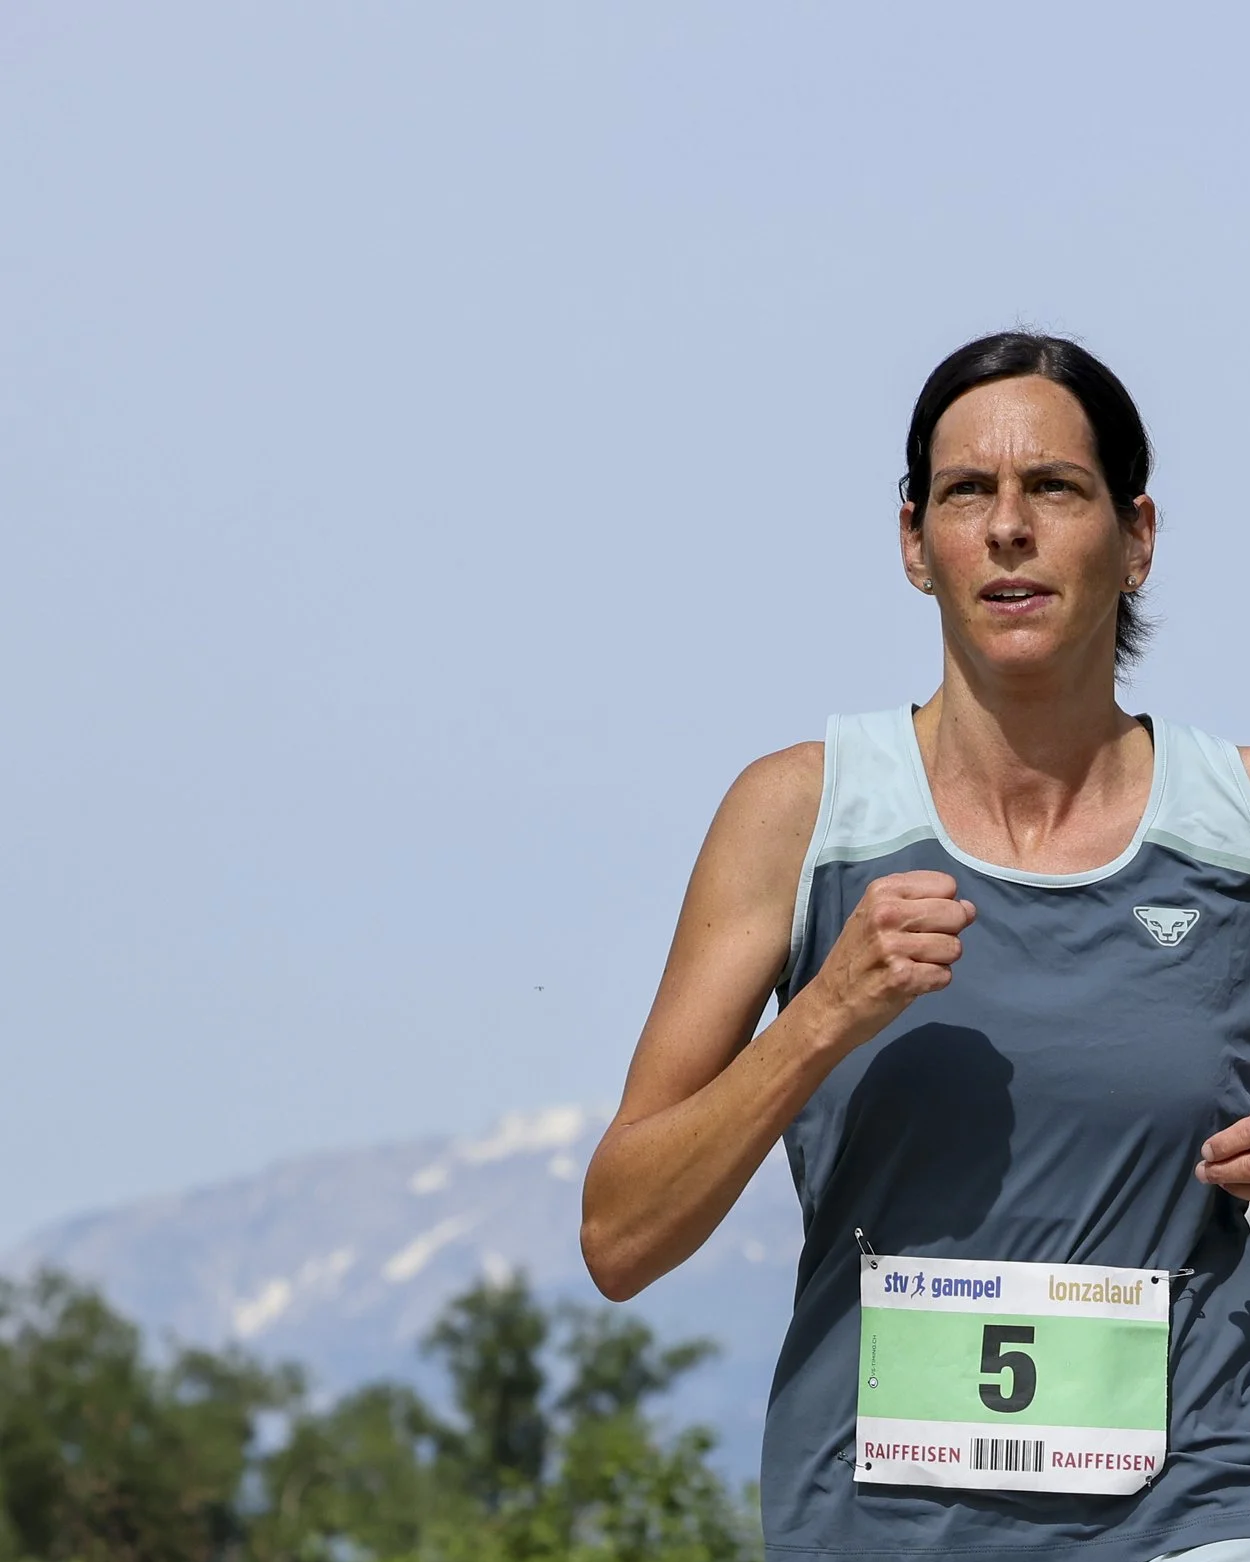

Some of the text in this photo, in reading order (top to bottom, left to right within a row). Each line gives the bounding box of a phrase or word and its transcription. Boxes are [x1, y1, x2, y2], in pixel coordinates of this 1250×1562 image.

[884, 1271, 1143, 1305] stv gampel lonzalauf
[978, 1324, 1037, 1413] 5
[864, 1441, 1156, 1472] RAIFFEISEN RAIFFEISEN
